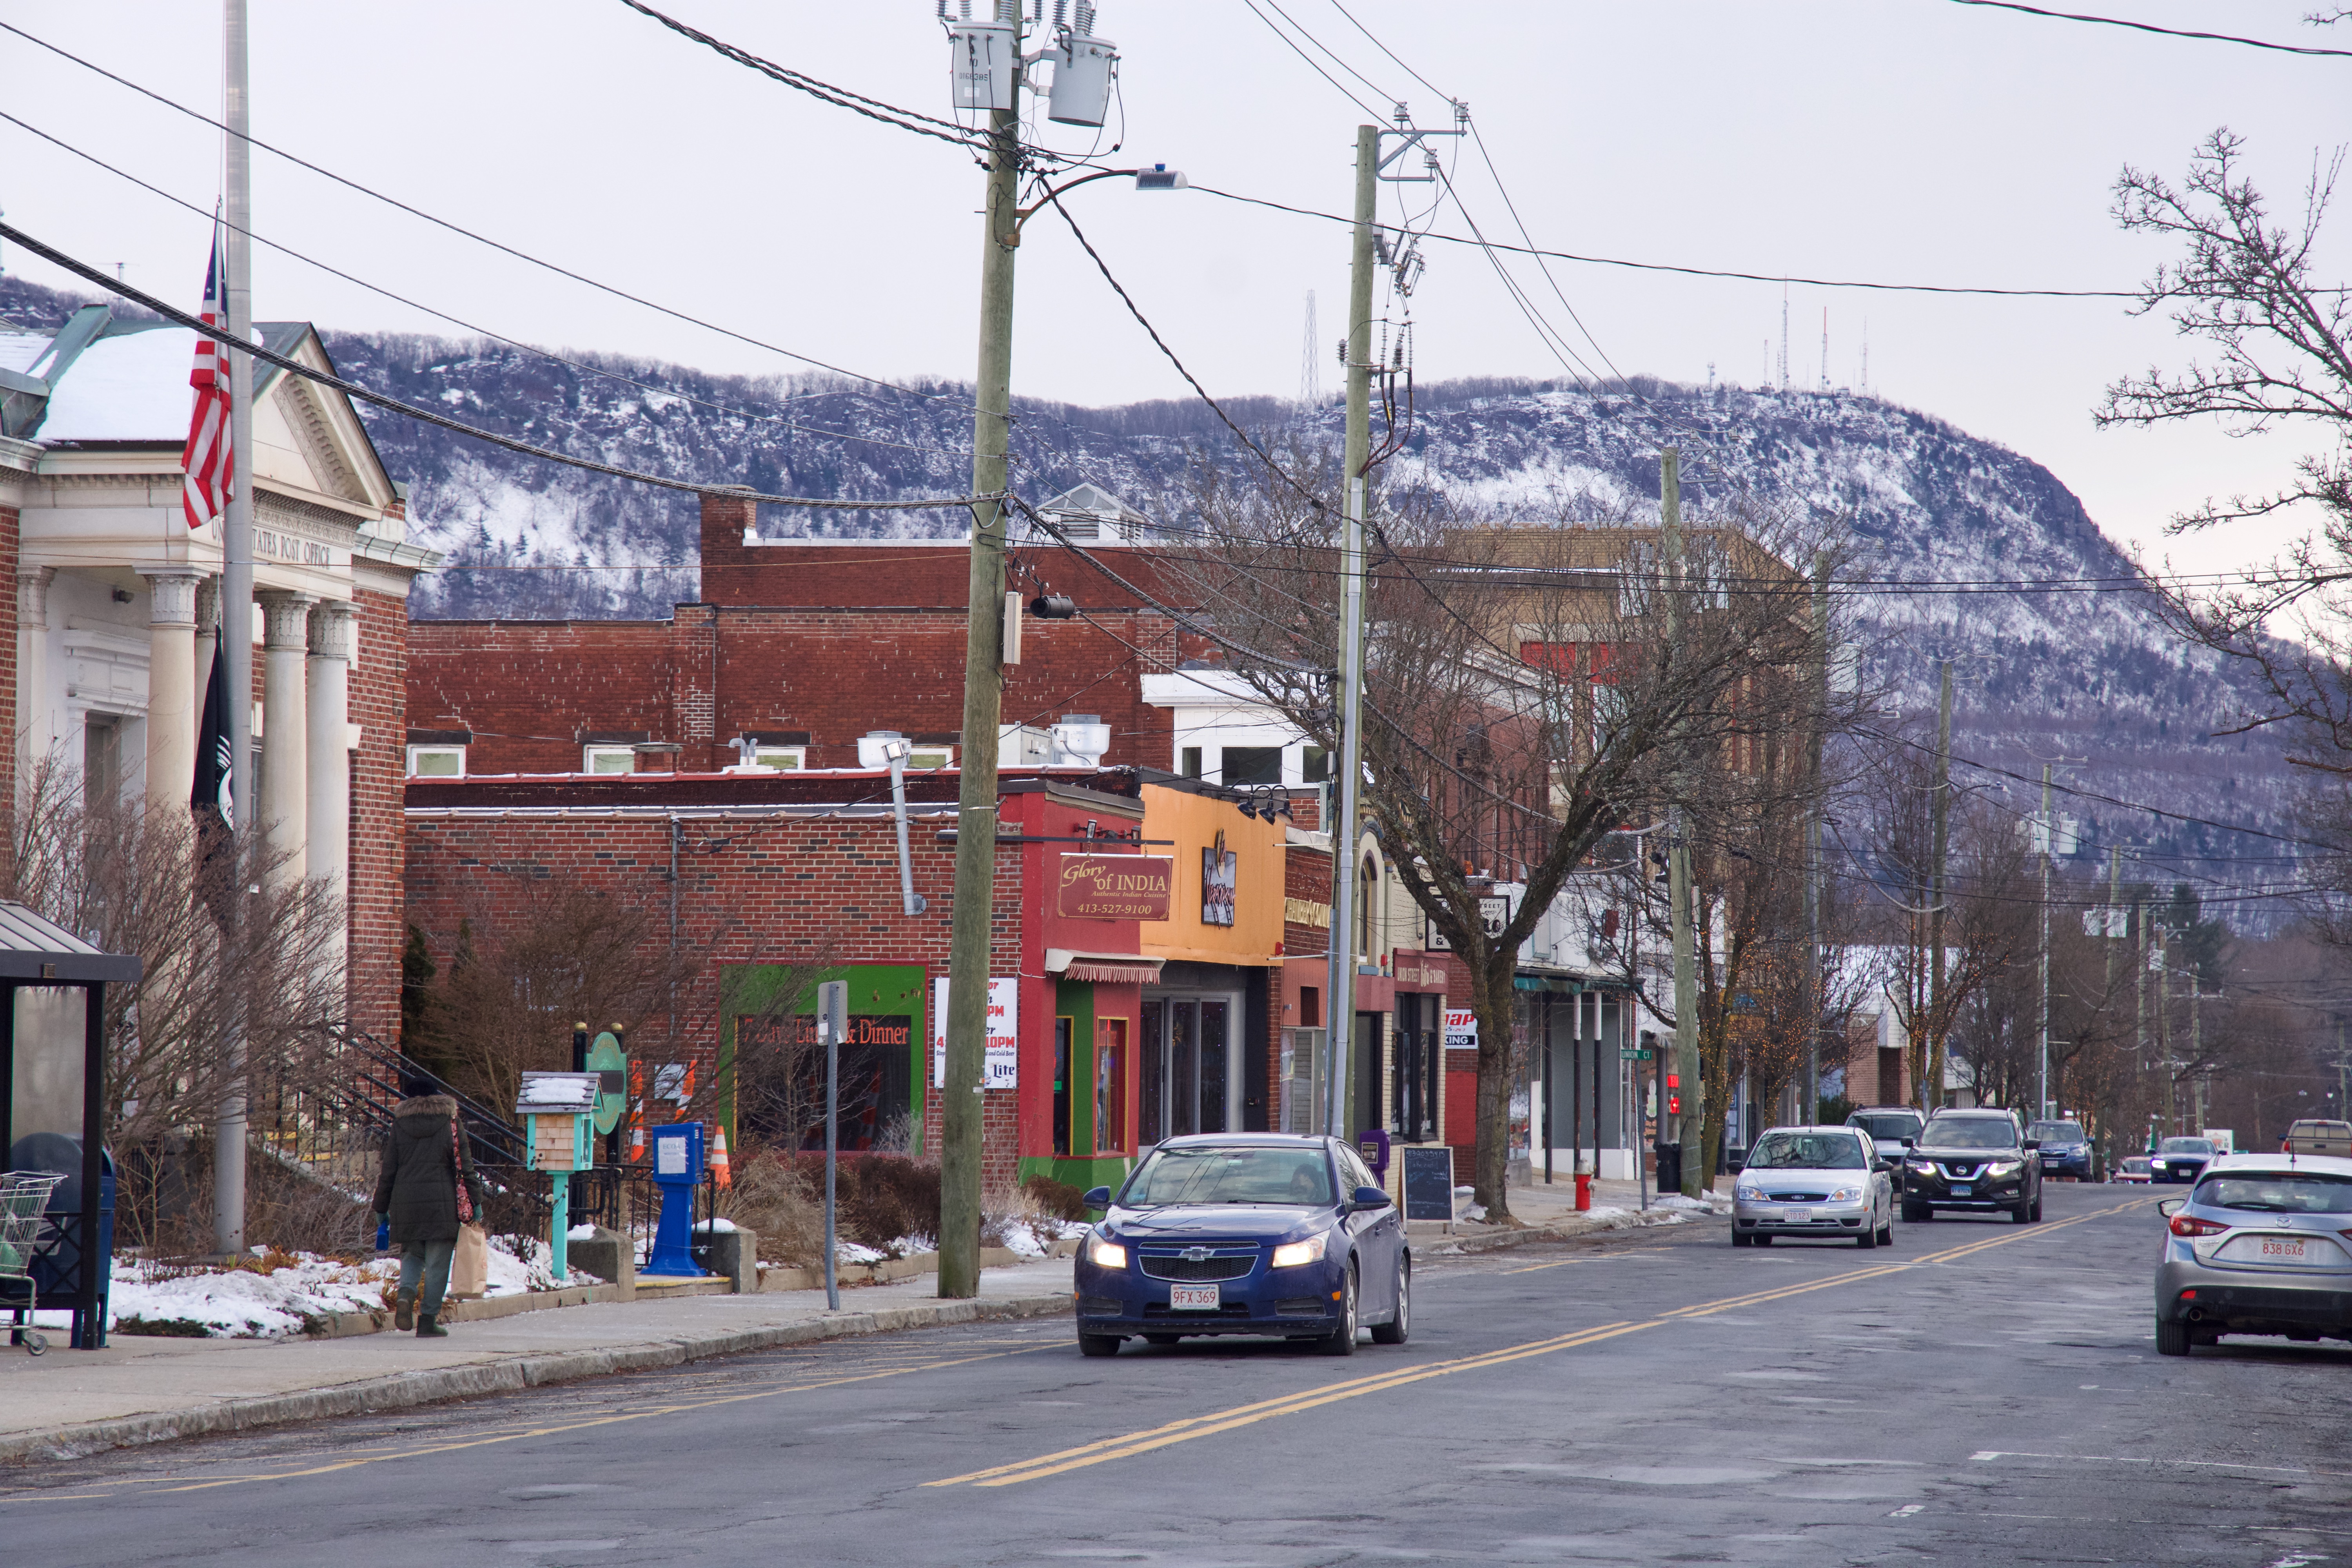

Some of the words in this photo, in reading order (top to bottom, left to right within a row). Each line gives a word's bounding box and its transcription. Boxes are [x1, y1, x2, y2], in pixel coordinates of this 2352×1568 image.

[252, 529, 276, 557] TATES
[281, 535, 299, 562] POST
[303, 542, 329, 570] OFFICE
[1061, 860, 1106, 887] Glory
[1096, 873, 1114, 890] of
[1117, 875, 1166, 891] INDIA
[1078, 904, 1152, 914] 413-527-9100
[1408, 968, 1419, 983] STREET
[987, 1005, 1004, 1017] PM
[860, 1019, 909, 1044] Dinner
[1445, 1036, 1469, 1044] KING
[993, 1064, 1015, 1078] Lite
[2263, 1243, 2282, 1254] 838
[2285, 1244, 2304, 1256] GX6
[1174, 1291, 1193, 1303] 9FX
[1196, 1291, 1216, 1303] 369
